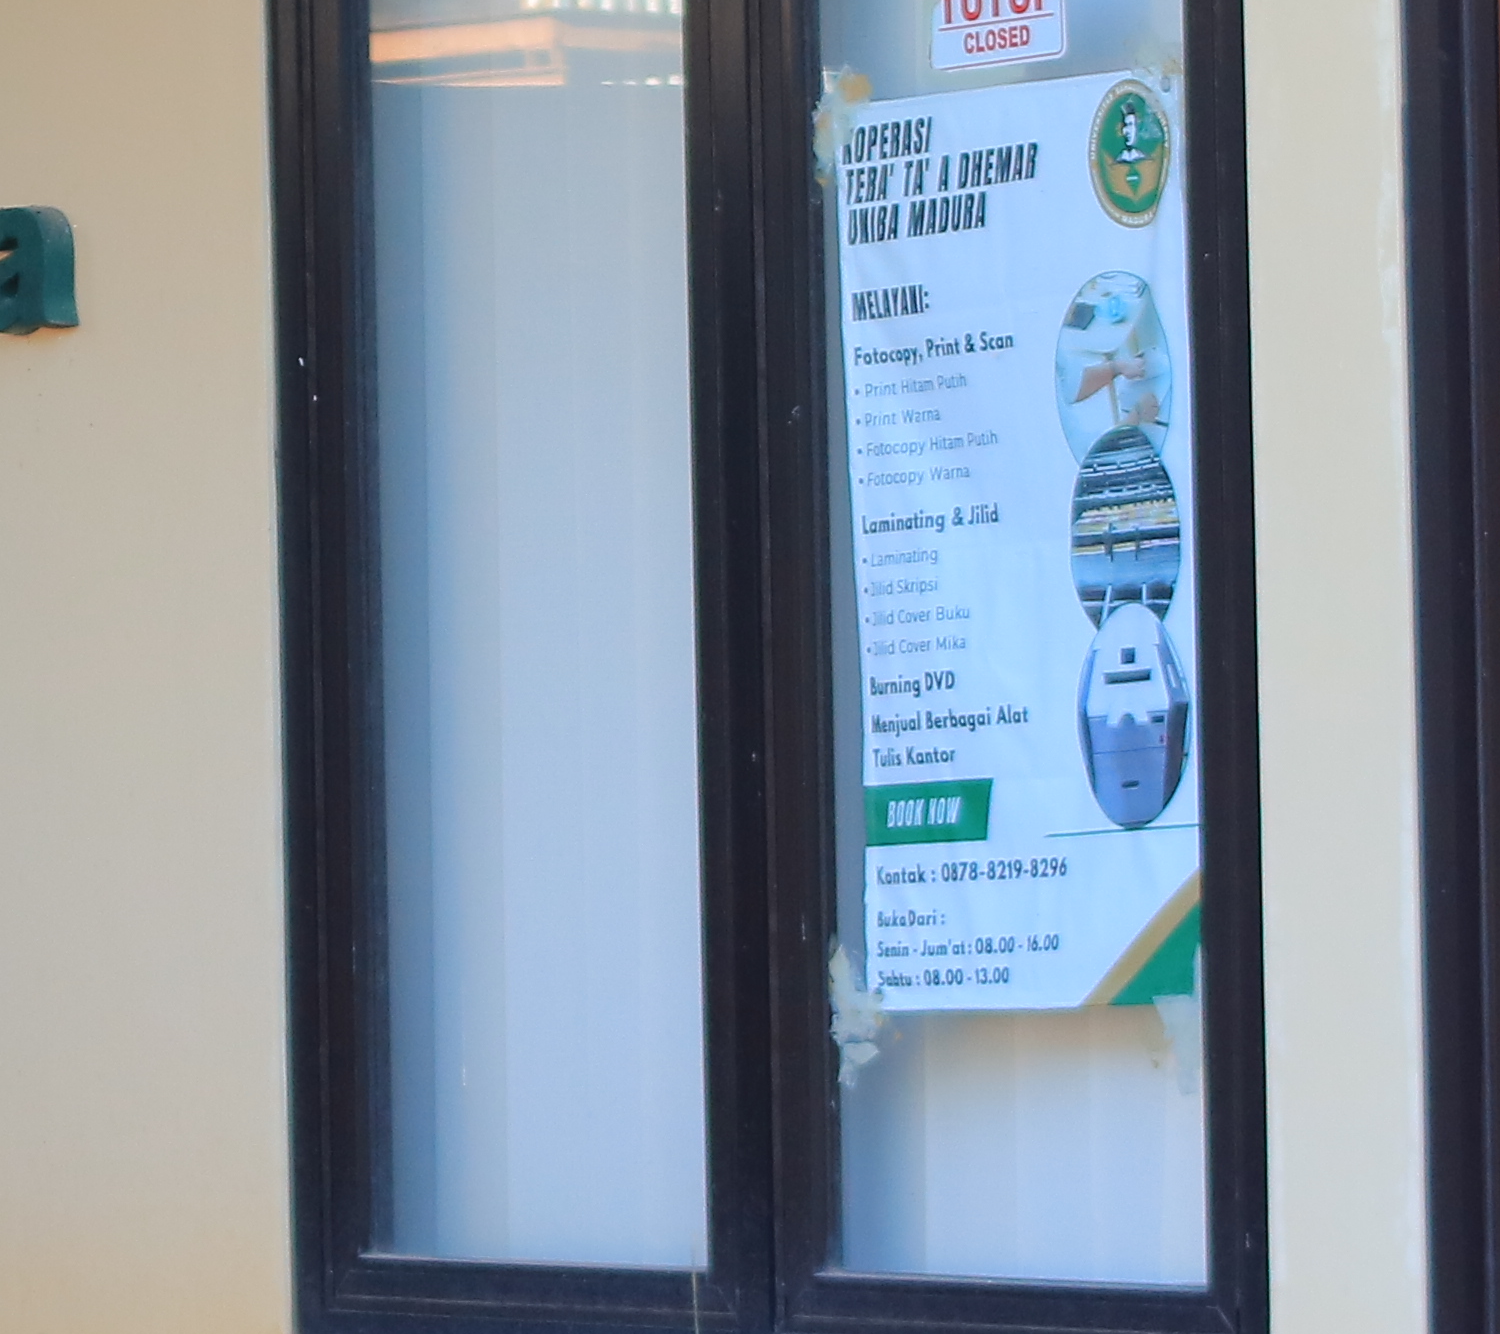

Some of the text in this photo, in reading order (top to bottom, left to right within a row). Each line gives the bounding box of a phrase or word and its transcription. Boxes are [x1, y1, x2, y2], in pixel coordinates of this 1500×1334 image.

[964, 25, 1030, 54] CLOSED
[904, 158, 929, 197] TA'
[938, 154, 949, 192] A
[956, 142, 1038, 189] DHEMAR
[848, 192, 987, 245] UNIBA MADURA
[851, 284, 929, 322] MELAYANI:
[854, 331, 1014, 366] Fotocopy, Print & Scan
[865, 373, 967, 397] Print Hitam Putih
[865, 408, 940, 427] Print Warna
[866, 430, 998, 457] Fotocopy Hitam Putih
[867, 465, 970, 487] Fotocopy Warna
[862, 502, 999, 534] Laminating & Jilid
[871, 549, 938, 567] Laminating
[897, 576, 938, 595] Skripsi
[897, 609, 931, 624] Cover
[936, 605, 970, 621] Buku
[899, 639, 931, 654] Cover
[936, 636, 966, 651] Mika
[869, 670, 955, 697] Burning DVD
[871, 704, 1029, 737] Menjual Berbagai Alat
[873, 746, 956, 767] Tulis Kantor
[887, 796, 962, 828] BOOK NOW
[876, 864, 926, 885] Kontak
[941, 857, 1067, 883] 0878-8219-8296
[877, 940, 909, 958] Senin
[975, 936, 1015, 954] 08.00
[1027, 934, 1060, 952] 16.00
[878, 969, 912, 987] Sabtu
[923, 969, 964, 987] 08.00
[975, 966, 1009, 984] 13.00
